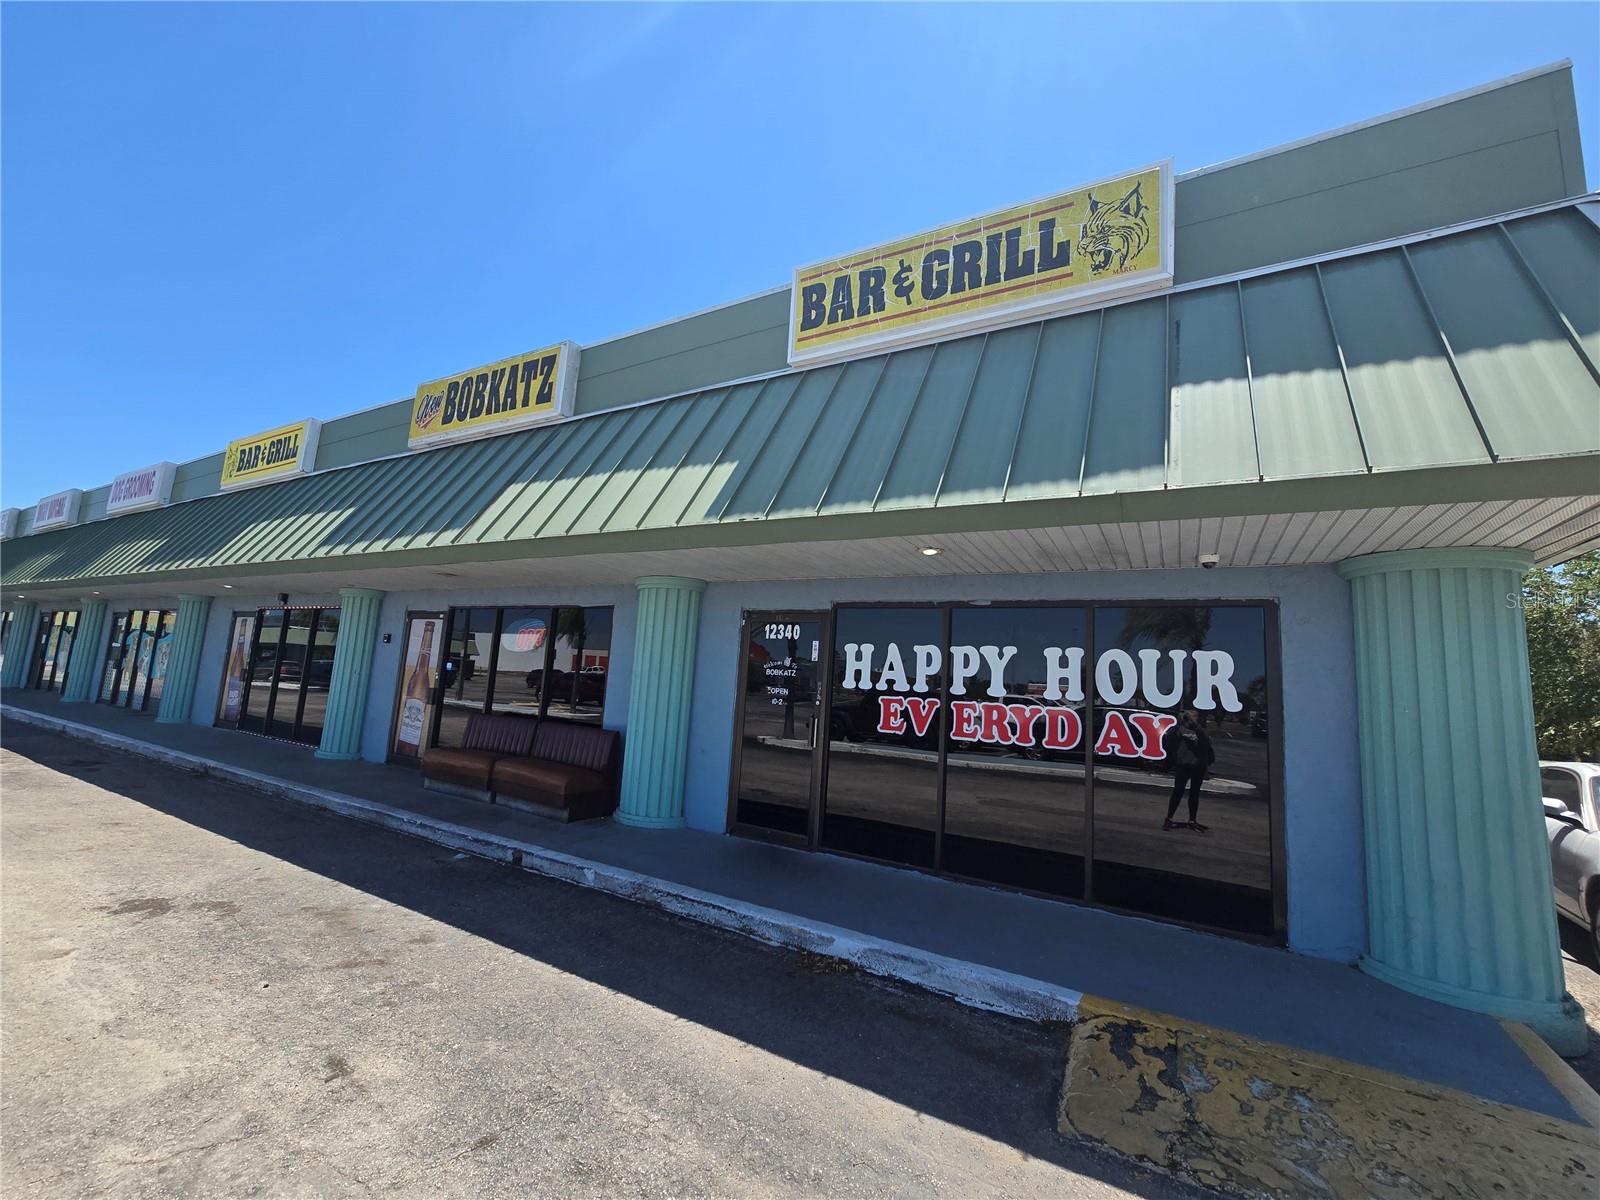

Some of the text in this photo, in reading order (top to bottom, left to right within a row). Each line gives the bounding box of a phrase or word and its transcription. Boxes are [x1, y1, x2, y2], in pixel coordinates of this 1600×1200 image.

[800, 217, 1071, 333] BAR & GRILL
[441, 354, 558, 426] BOBKATZ
[236, 444, 262, 473] BAR
[266, 433, 299, 466] GRILL
[764, 624, 799, 639] 12340
[766, 668, 796, 676] BOBKATZ
[770, 687, 789, 695] OPEN
[842, 643, 1243, 713] HAPPY HOUR
